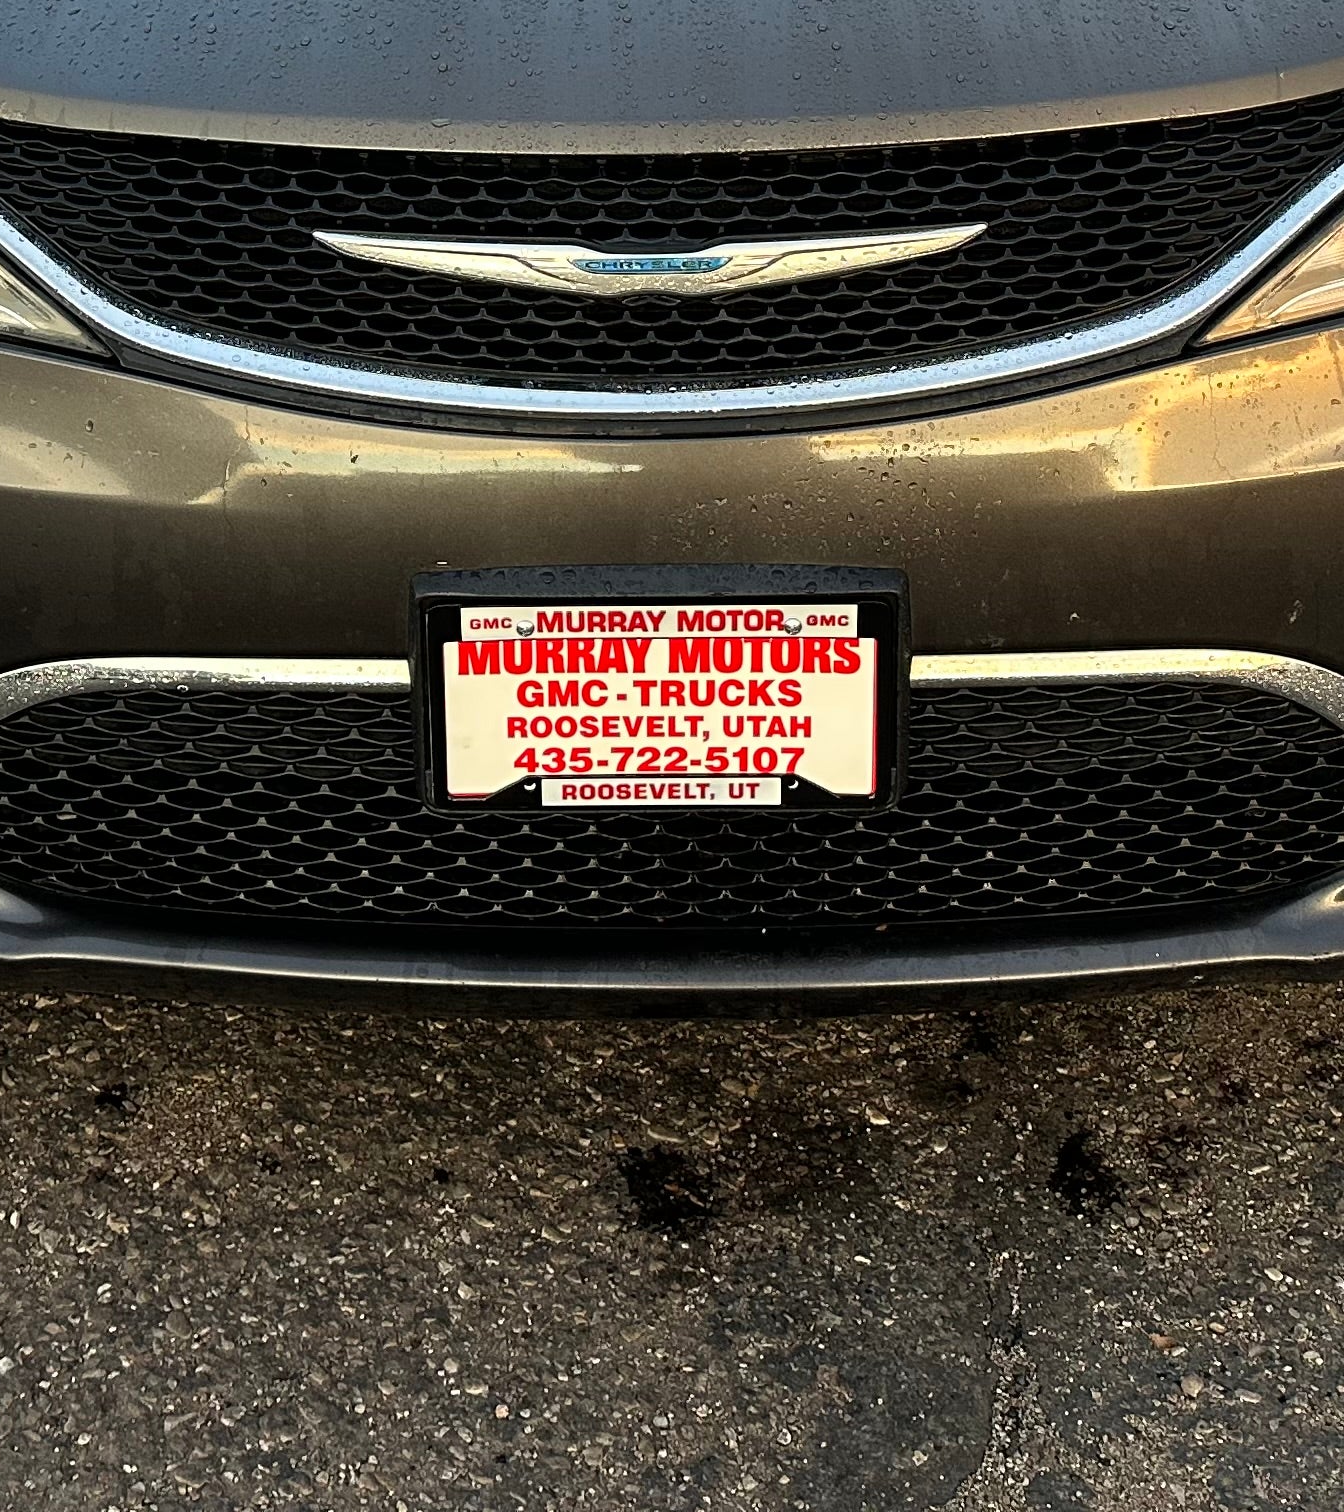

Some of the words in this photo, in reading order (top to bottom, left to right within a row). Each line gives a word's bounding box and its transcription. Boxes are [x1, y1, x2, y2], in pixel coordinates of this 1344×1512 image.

[585, 259, 712, 270] CHRYSLER
[469, 618, 512, 629] GMC
[537, 610, 667, 632] MURRAY
[806, 615, 849, 626] GMC
[458, 639, 652, 675] MURRAY
[669, 638, 861, 674] MOTORS
[507, 715, 710, 742] ROOSEVELT,
[723, 715, 812, 738] UTAH
[514, 746, 805, 773] 435-722-5107
[562, 783, 715, 800] ROOSEVELT,
[729, 783, 760, 799] UT
